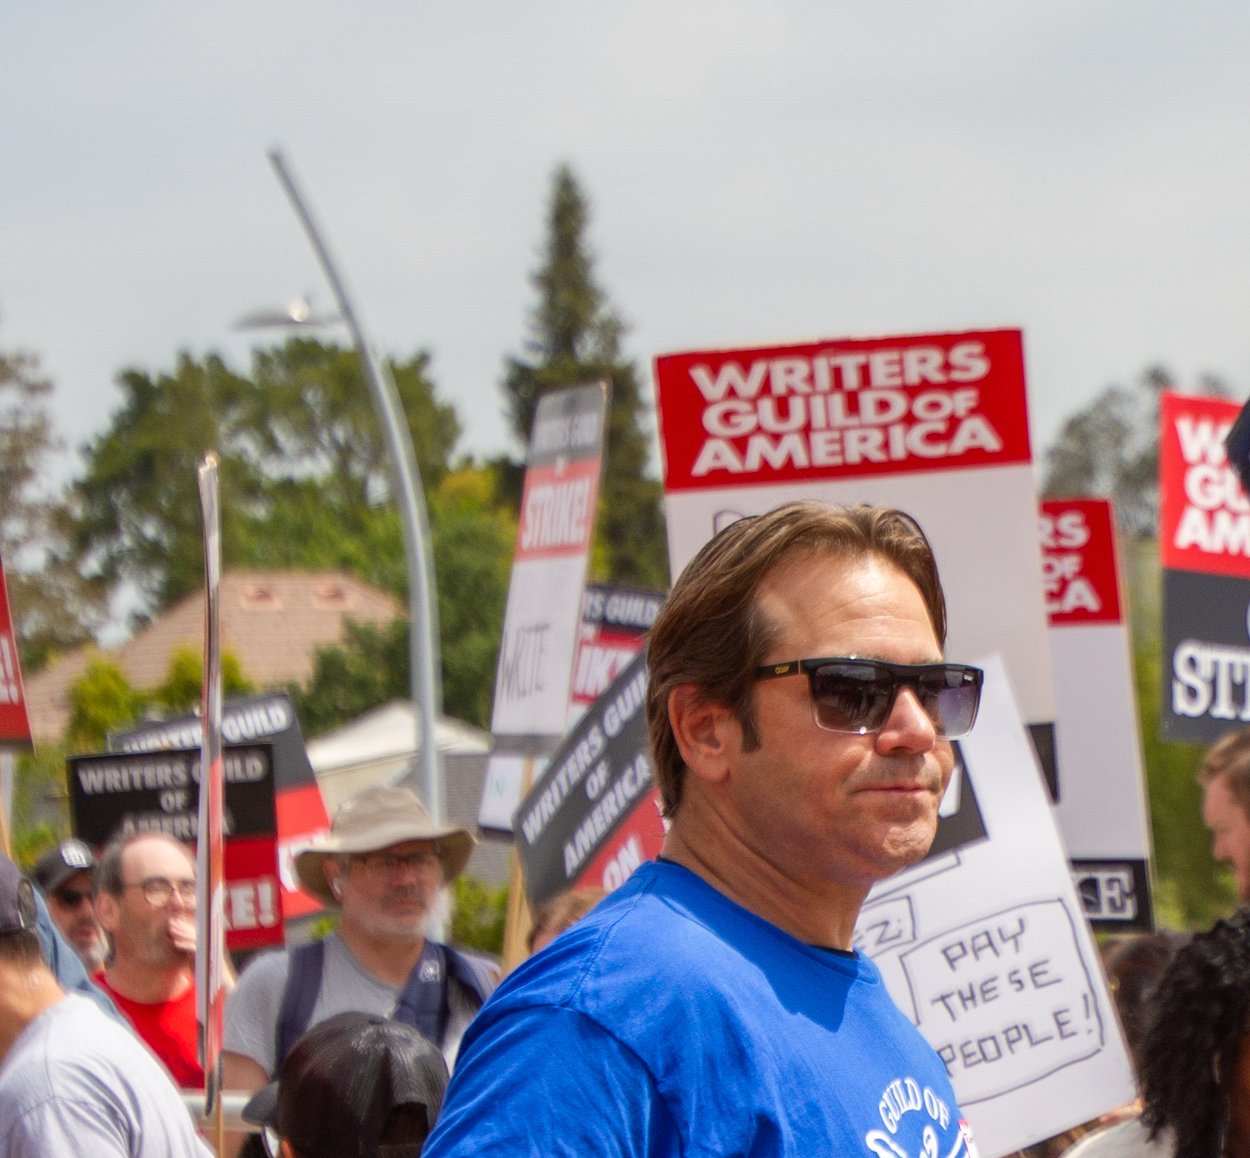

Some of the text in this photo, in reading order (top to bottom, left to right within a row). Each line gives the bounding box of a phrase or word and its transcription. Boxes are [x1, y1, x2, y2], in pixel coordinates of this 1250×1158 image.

[689, 341, 990, 402] WRITERS
[702, 388, 979, 438] GUILD OF
[691, 415, 1003, 477] AMERICA
[221, 703, 289, 744] GUILD
[78, 761, 187, 796] WRITERS
[160, 789, 188, 813] OF
[522, 724, 605, 846] WRITERS
[586, 759, 610, 801] OF
[563, 753, 650, 879] AMERICA
[941, 917, 1028, 973] PAY
[930, 958, 1064, 1024] THESE
[937, 992, 1096, 1079] PEOPLE!
[878, 1076, 923, 1135] GUILD
[922, 1086, 950, 1132] OF
